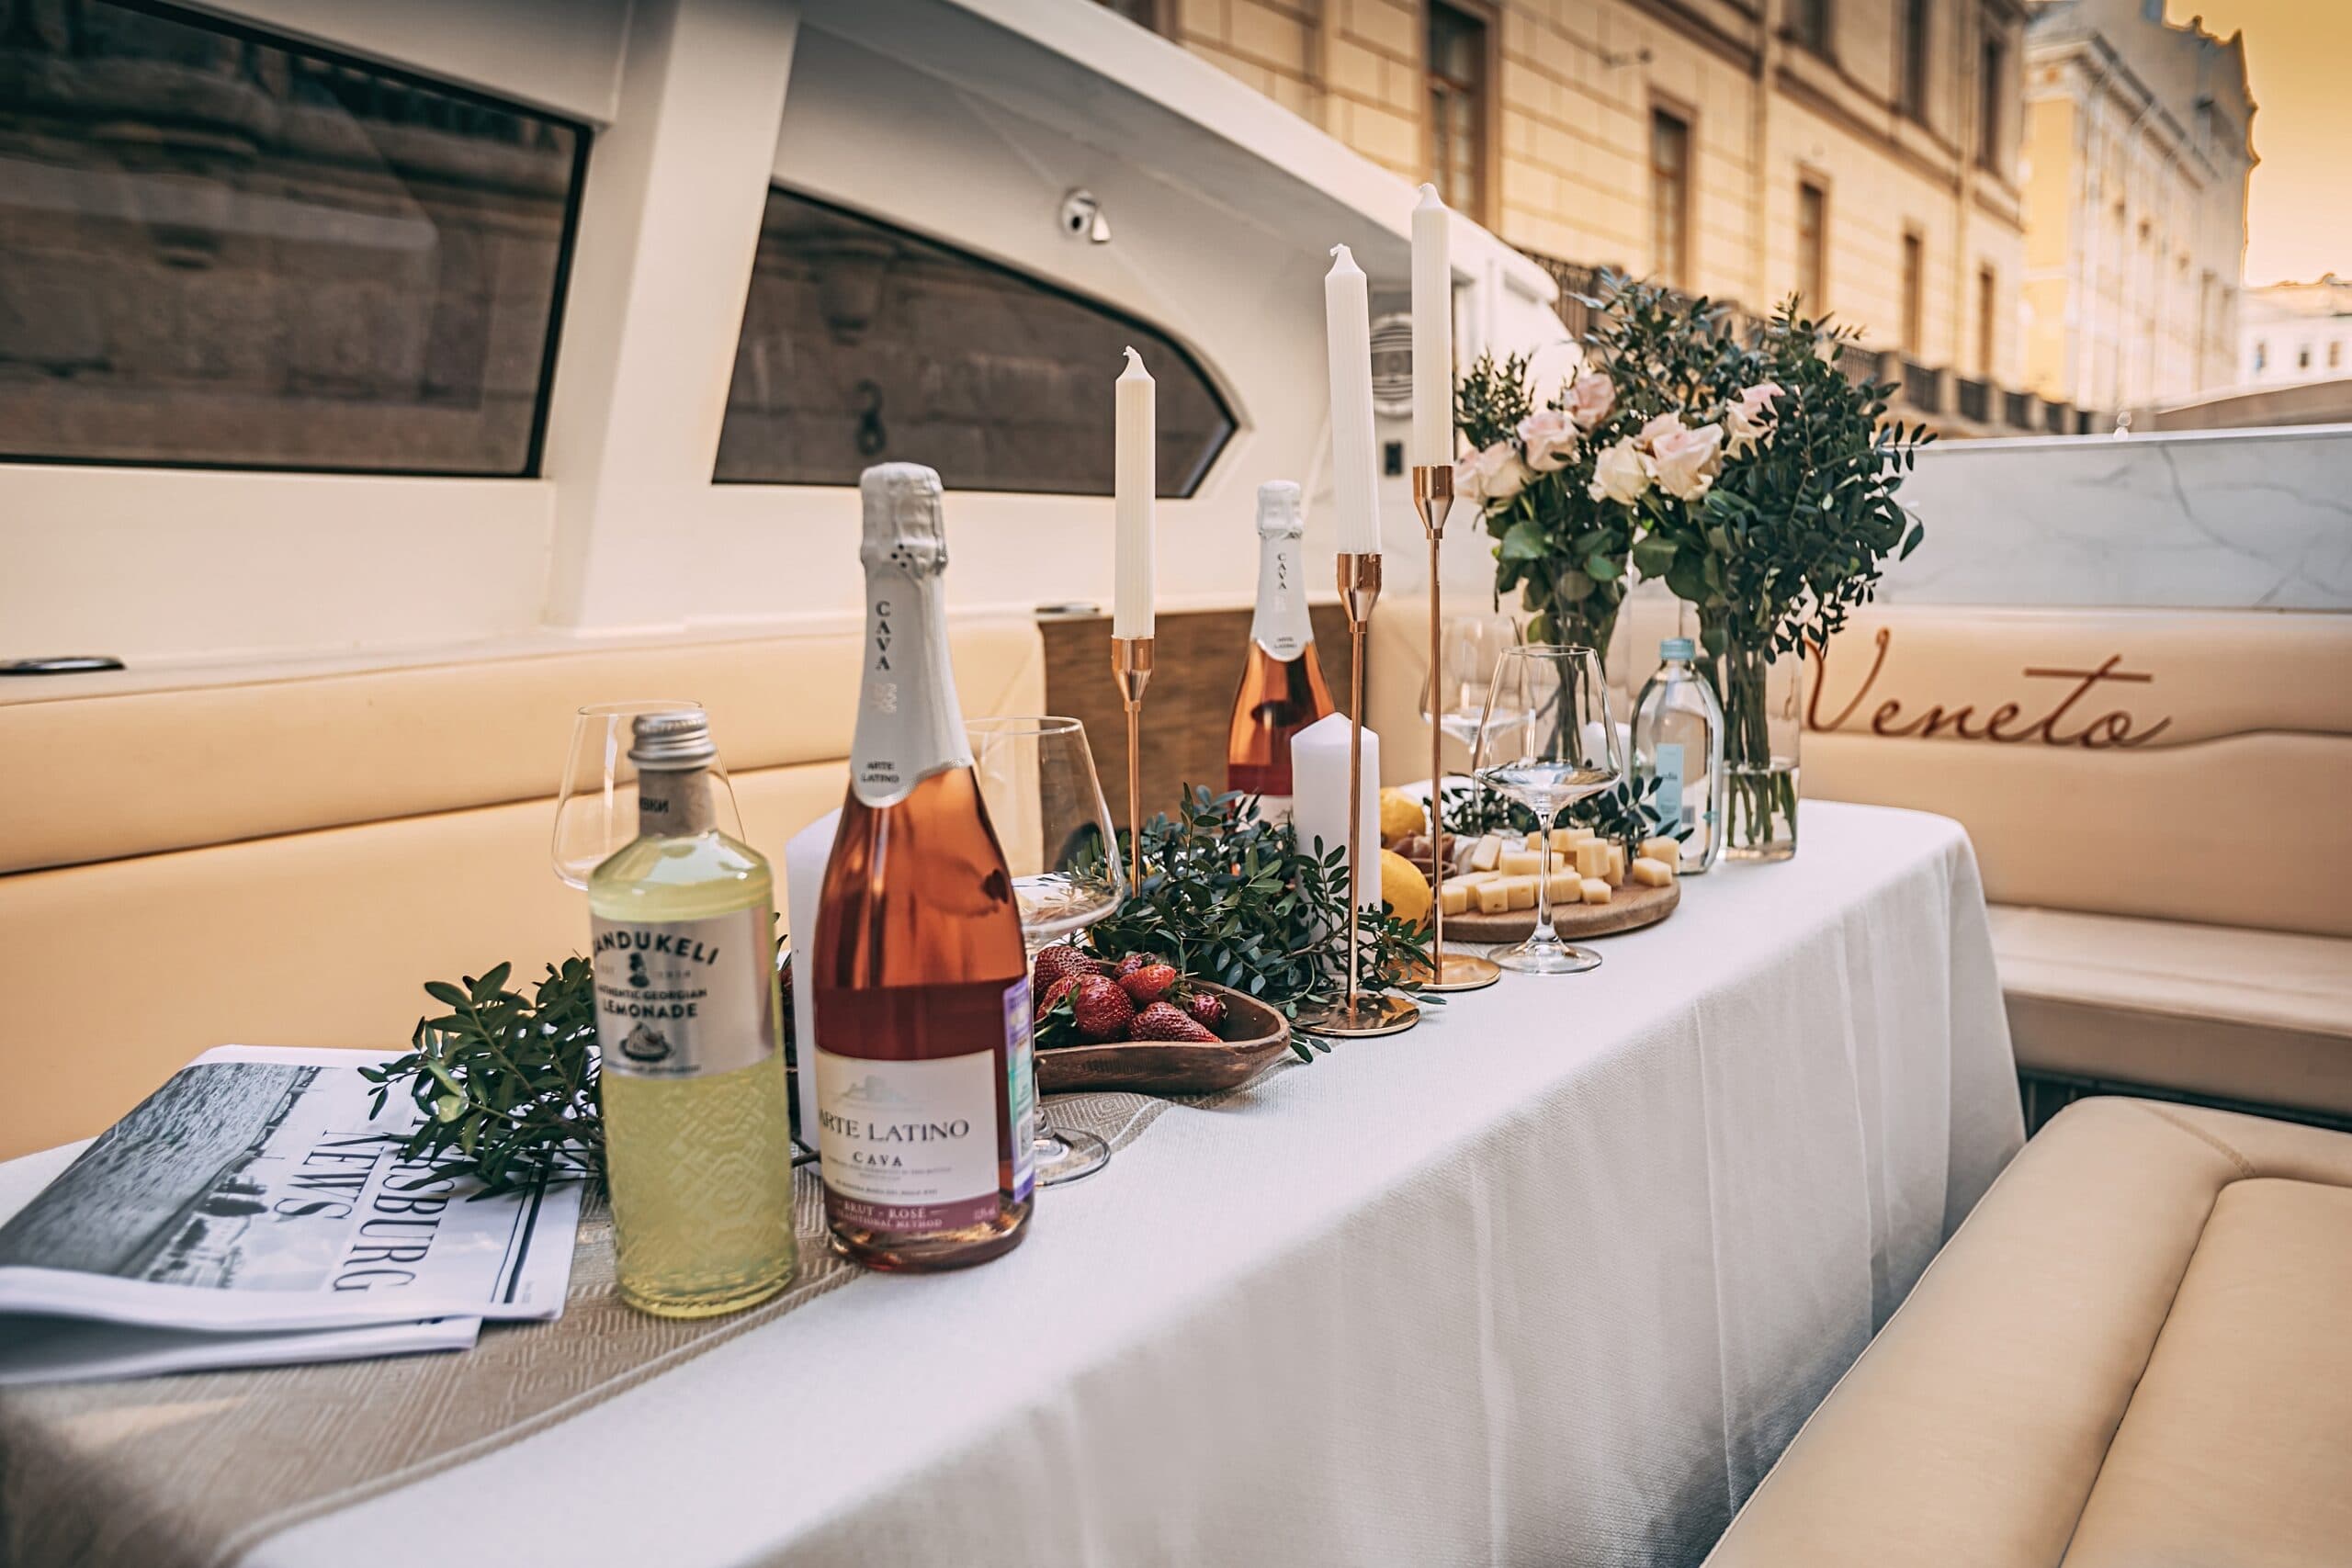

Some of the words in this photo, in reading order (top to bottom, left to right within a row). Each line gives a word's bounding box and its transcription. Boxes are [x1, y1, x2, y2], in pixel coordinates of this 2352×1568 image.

[1277, 553, 1287, 589] CAVA
[876, 601, 891, 671] CAVA
[1804, 627, 2172, 750] Veneto
[861, 773, 899, 783] LATINO
[603, 998, 698, 1019] LEMONADE
[819, 1108, 860, 1139] ARTE
[868, 1119, 970, 1143] LATINO
[274, 1129, 386, 1219] NEWS
[853, 1151, 903, 1167] CAVA
[844, 1201, 875, 1216] BRUT
